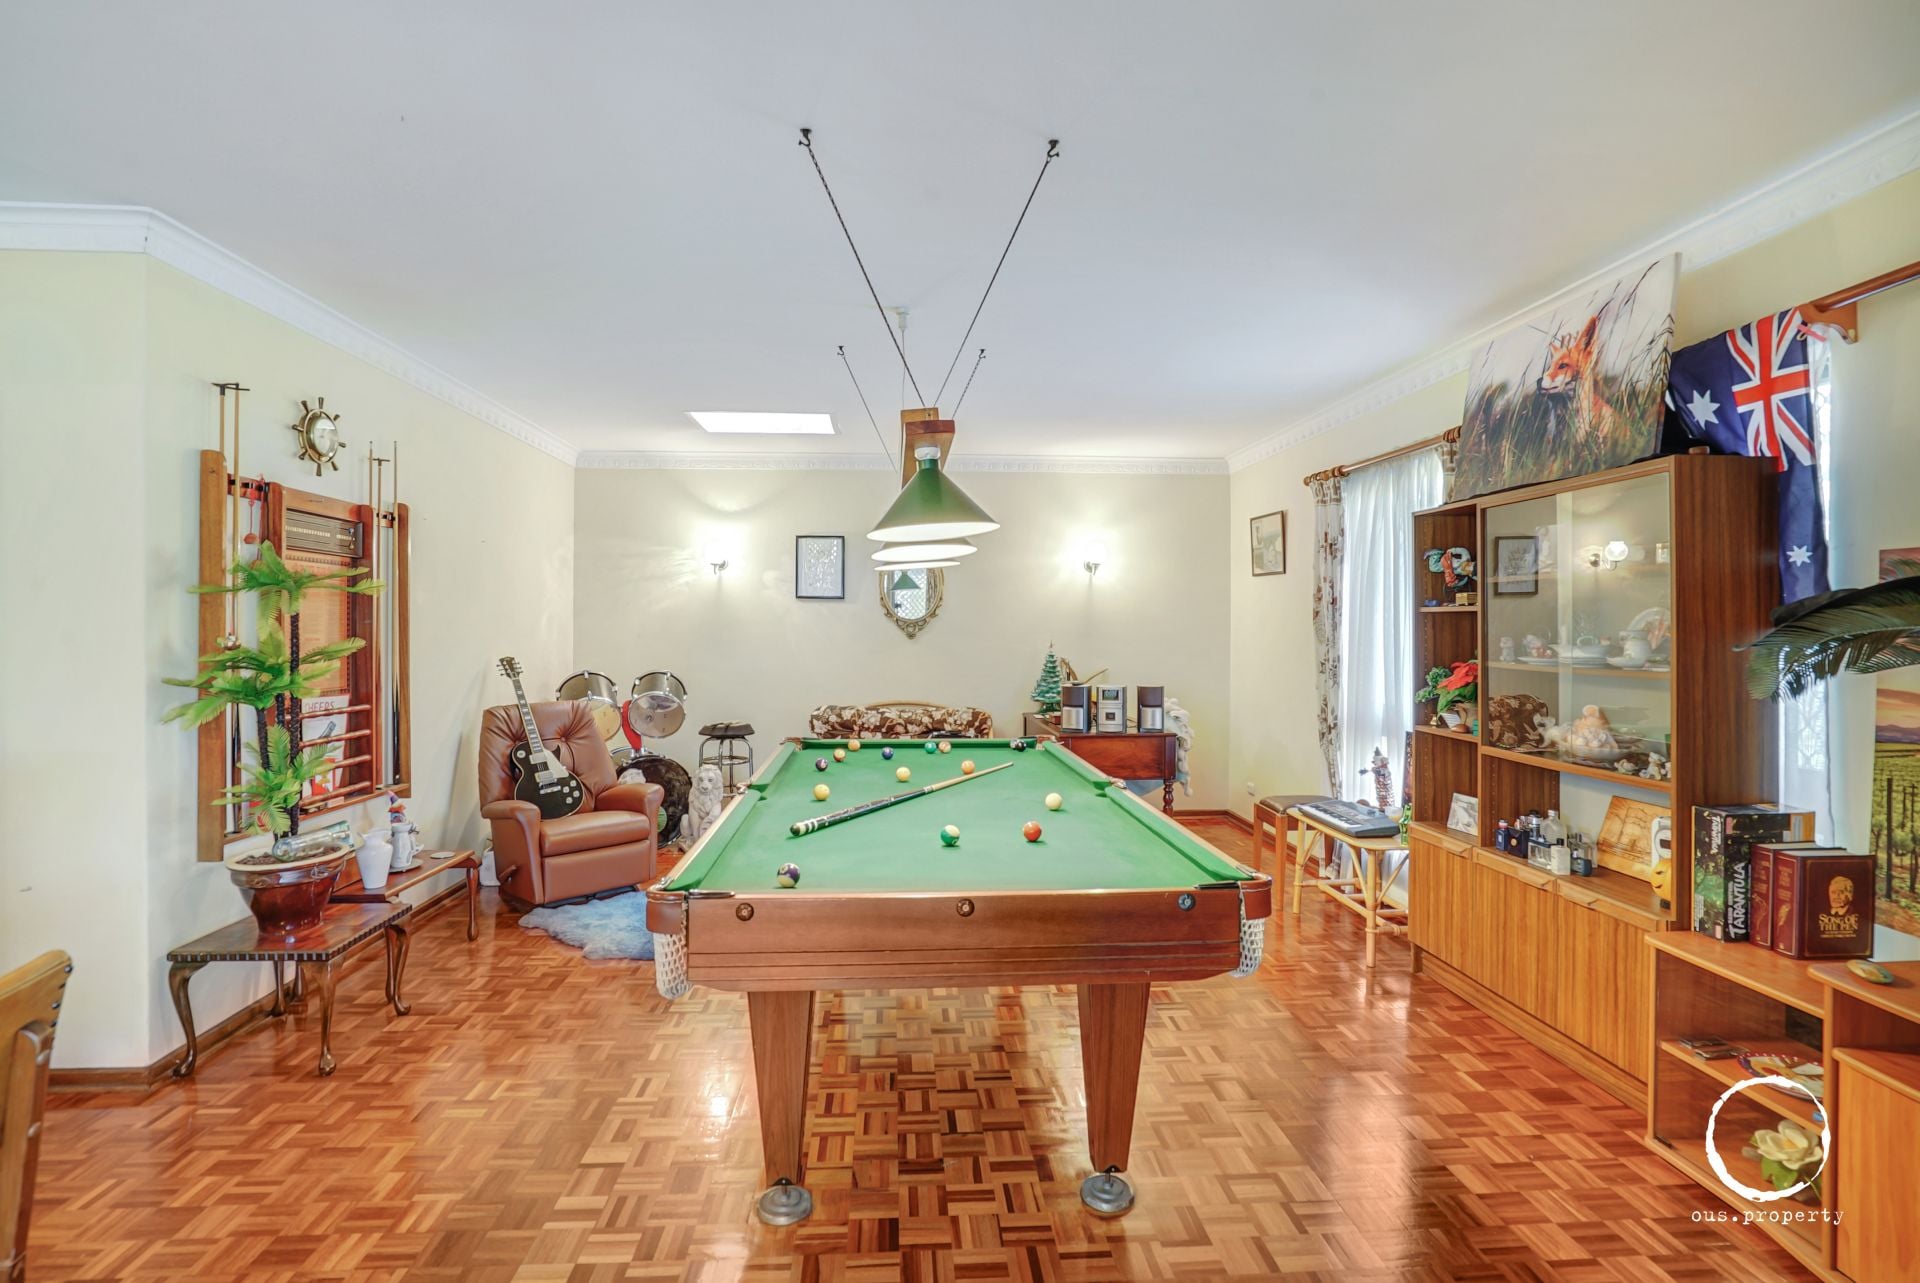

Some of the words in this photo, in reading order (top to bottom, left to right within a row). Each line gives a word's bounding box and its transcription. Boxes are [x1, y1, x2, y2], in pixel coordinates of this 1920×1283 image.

[1729, 862, 1746, 939] TARANTULA
[1818, 914, 1843, 925] SONG
[1844, 914, 1859, 924] OF
